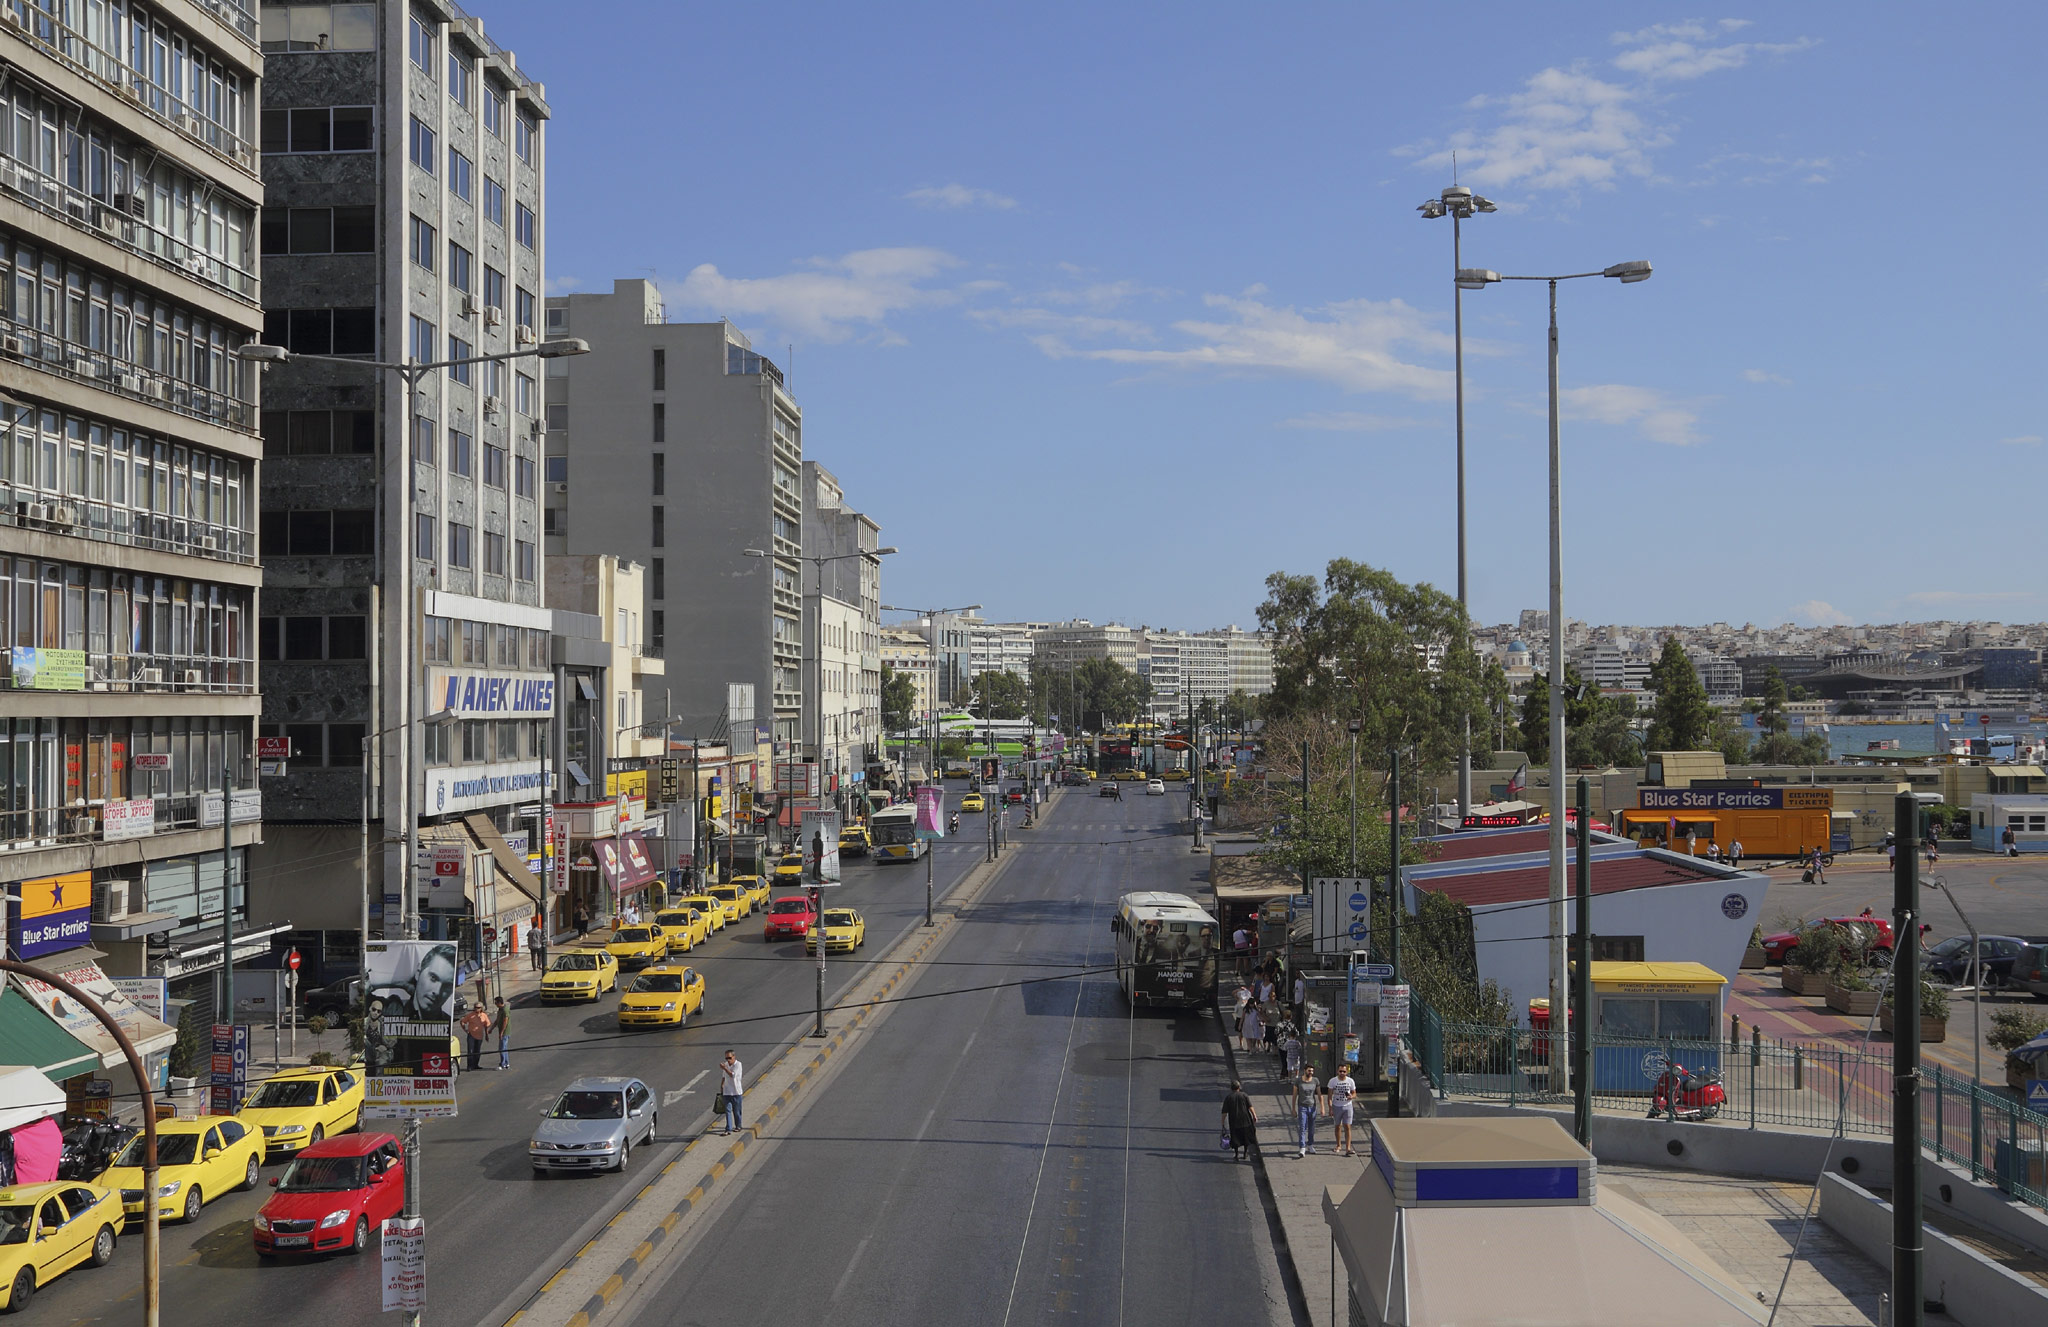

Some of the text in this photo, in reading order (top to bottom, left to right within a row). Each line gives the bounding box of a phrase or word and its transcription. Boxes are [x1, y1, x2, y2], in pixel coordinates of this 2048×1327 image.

[462, 676, 554, 711] ANEK LINES
[136, 756, 152, 766] ΑΓΟΡΕΣ
[662, 761, 670, 796] GOLD
[1644, 792, 1770, 806] Blue Star Ferries
[104, 806, 154, 820] ΑΓΟΡΕΣ ΧΡΥΣΟΥ
[558, 824, 566, 888] INTERNET
[22, 920, 88, 946] Blue Star Ferries
[64, 967, 102, 985] CRUISES
[384, 1024, 450, 1036] ΧΑΤΖΗΓΙΑΝΝΗΣ
[370, 1078, 384, 1096] 12
[384, 1086, 411, 1096] ΙΟΥΛΙΟΥ
[384, 1228, 398, 1236] ΚΚΕ
